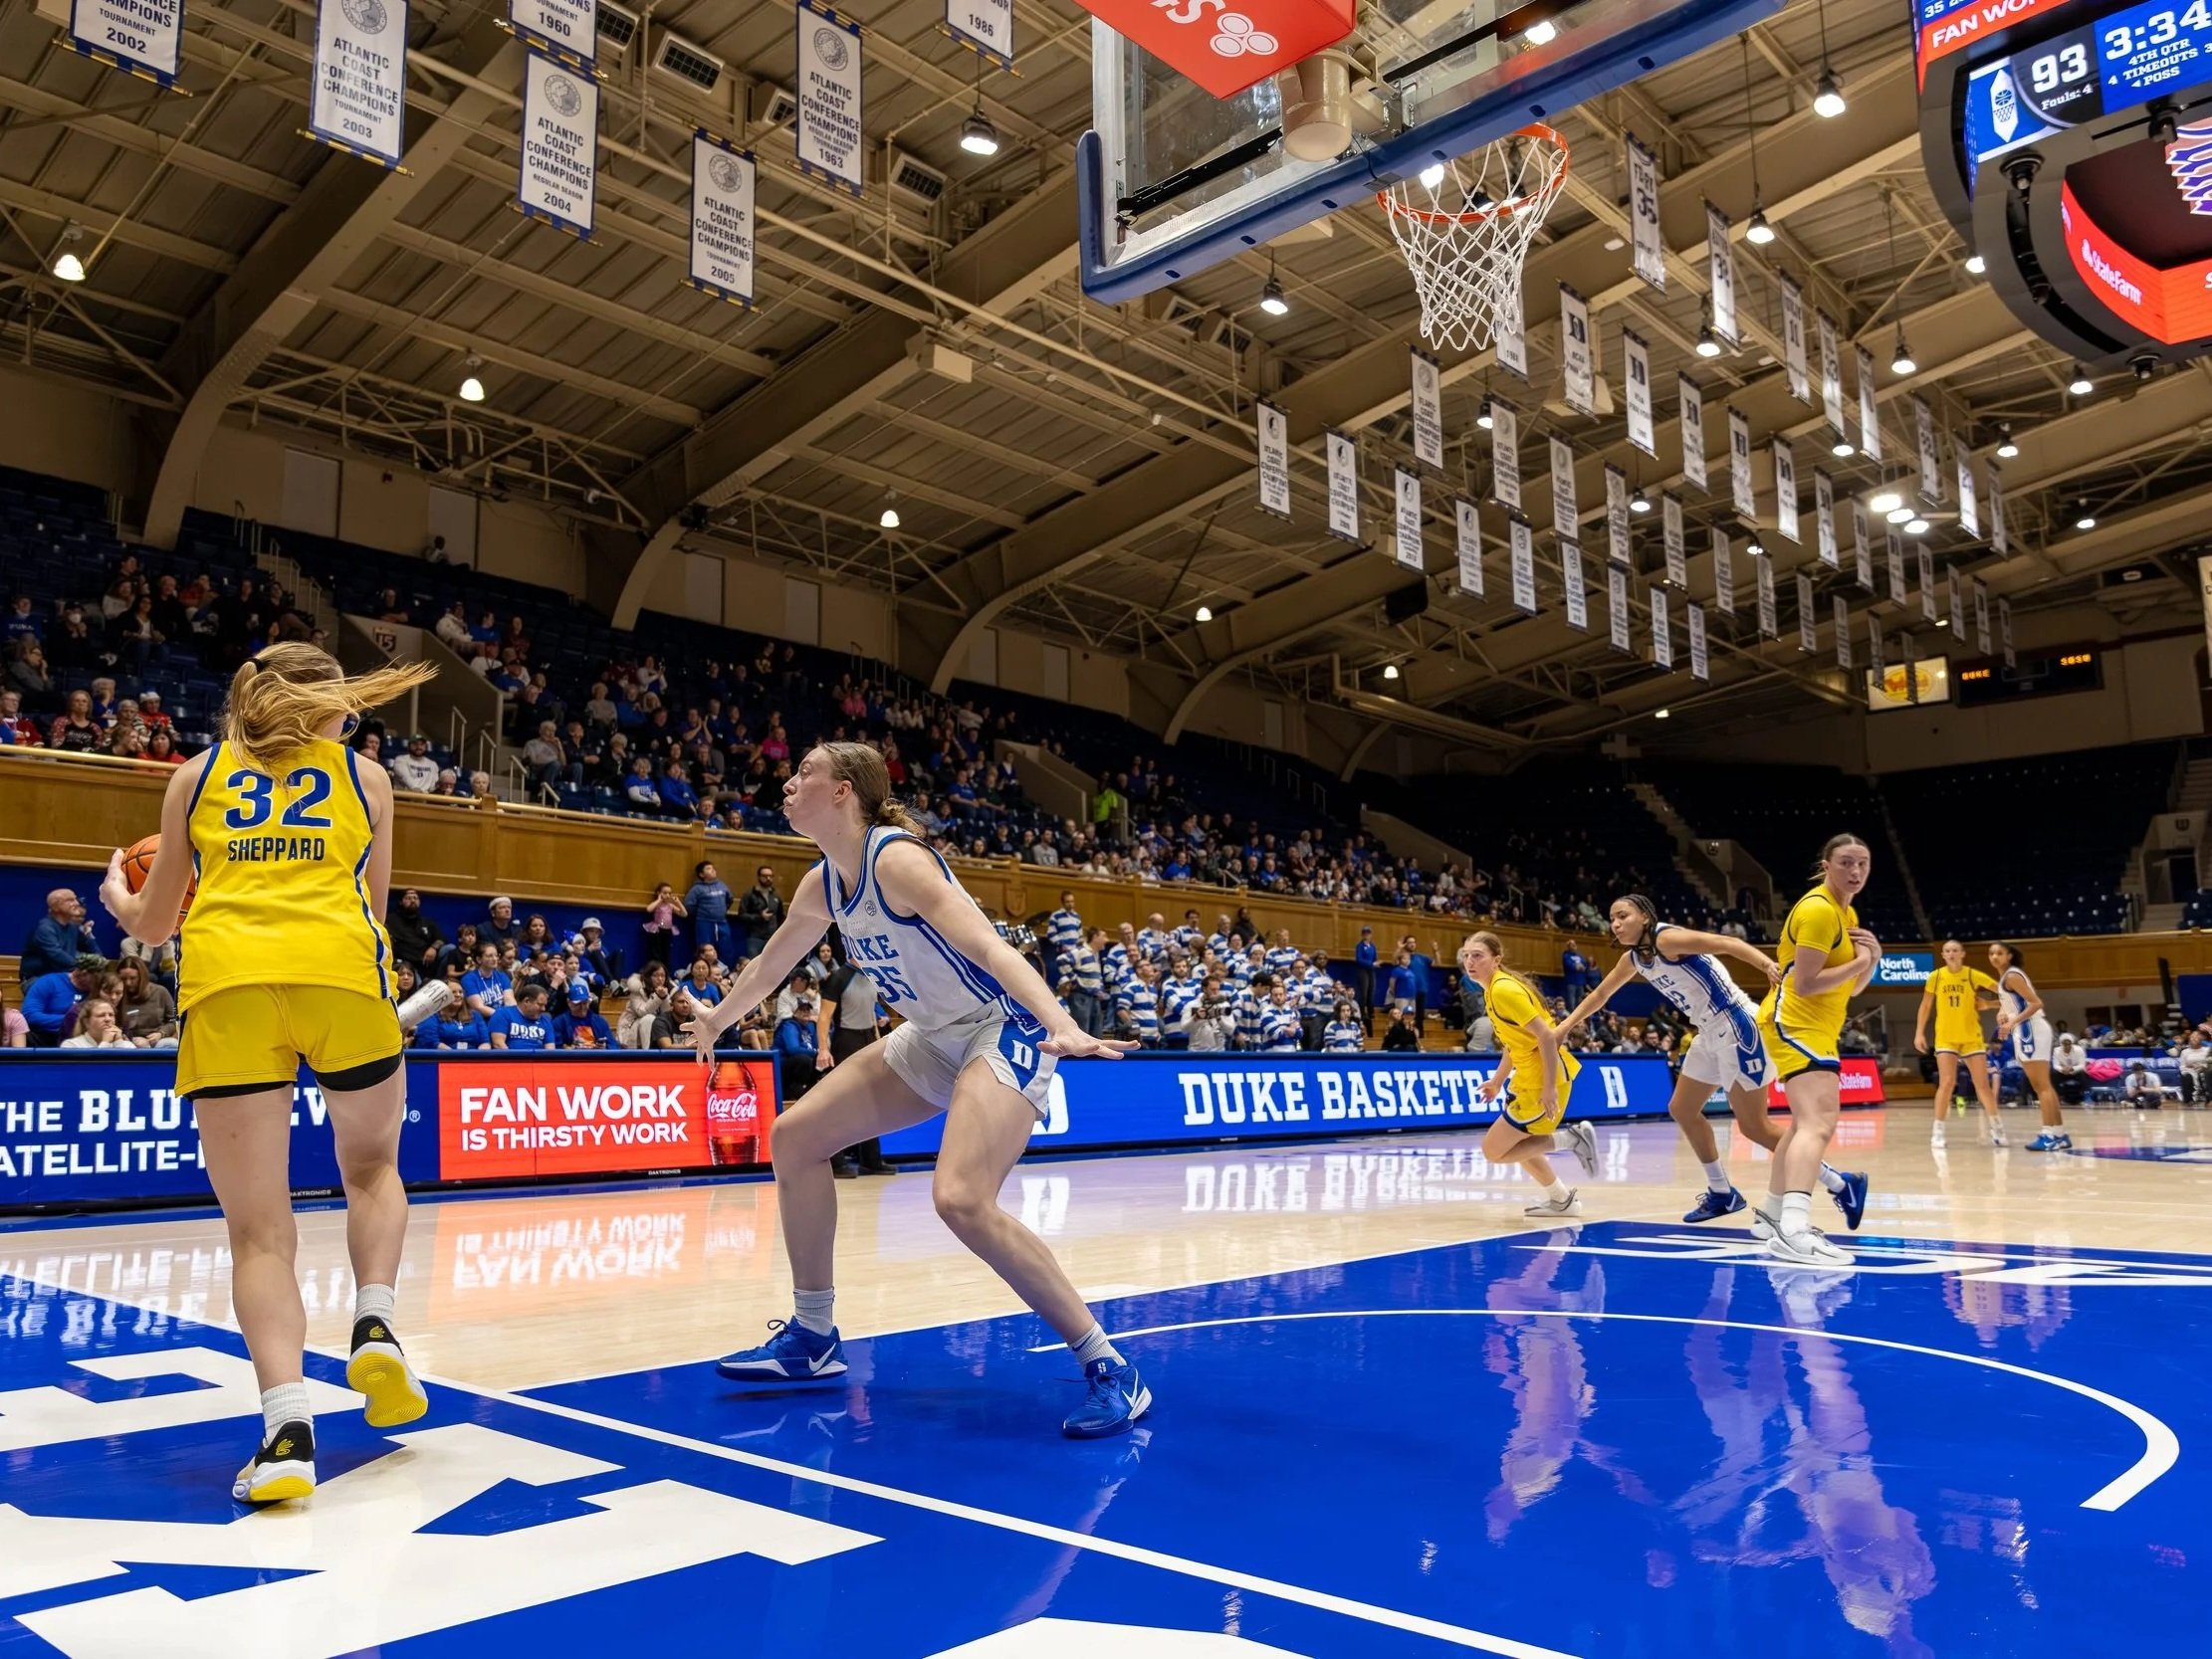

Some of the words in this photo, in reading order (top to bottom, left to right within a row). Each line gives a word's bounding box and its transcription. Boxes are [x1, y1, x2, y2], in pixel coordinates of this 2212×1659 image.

[99, 8, 156, 36] TOURNAMENT
[534, 0, 578, 21] OURNAMENT
[539, 12, 570, 37] 1960
[1924, 4, 1943, 19] 35
[969, 14, 994, 37] 1986
[1931, 14, 1978, 48] FAN
[2104, 0, 2212, 60] 3:34
[107, 27, 147, 54] 2002
[333, 37, 389, 69] ATLANTIC
[2128, 50, 2155, 67] 4TH
[2161, 38, 2191, 56] QTR
[341, 56, 380, 80] COAST
[2032, 43, 2088, 94] 93
[2107, 75, 2118, 86] 4
[2123, 48, 2199, 81] TIMEOUTS
[2143, 66, 2180, 87] POSS
[321, 62, 398, 104] CONFERENCE
[809, 72, 852, 101] ATLANTIC
[324, 79, 395, 116] CHAMPIONS
[334, 99, 382, 124] TOURNAMENT
[816, 89, 845, 111] COAST
[2041, 88, 2083, 111] Fouls:
[2082, 84, 2094, 96] 4
[801, 95, 860, 131] CONFERENCE
[804, 109, 858, 145] CHAMPIONS
[342, 117, 372, 138] 2003
[538, 116, 584, 147] ATLANTIC
[526, 139, 591, 178] CONFERENCE
[545, 133, 576, 157] COAST
[819, 148, 843, 169] 1963
[529, 155, 588, 190] CHAMPIONS
[544, 192, 571, 214] 2004
[704, 196, 745, 222] ATLANTIC
[695, 218, 753, 249] CONFERENCE
[710, 212, 738, 231] COAST
[698, 233, 750, 262] CHAMPIONS
[711, 266, 735, 285] 2005
[225, 767, 332, 830] 32
[228, 837, 326, 862] SHEPPARD
[1880, 957, 1915, 970] North
[1880, 969, 1932, 981] Carolina
[862, 965, 917, 1003] 35
[1949, 995, 1960, 1007] 11
[78, 1089, 198, 1133] BLU
[460, 1087, 547, 1124] FAN
[555, 1084, 688, 1122] WORK
[1178, 1072, 1310, 1125] DUKE
[461, 1128, 488, 1151] IS
[492, 1124, 605, 1150] THIRSTY
[610, 1122, 689, 1145] WORK
